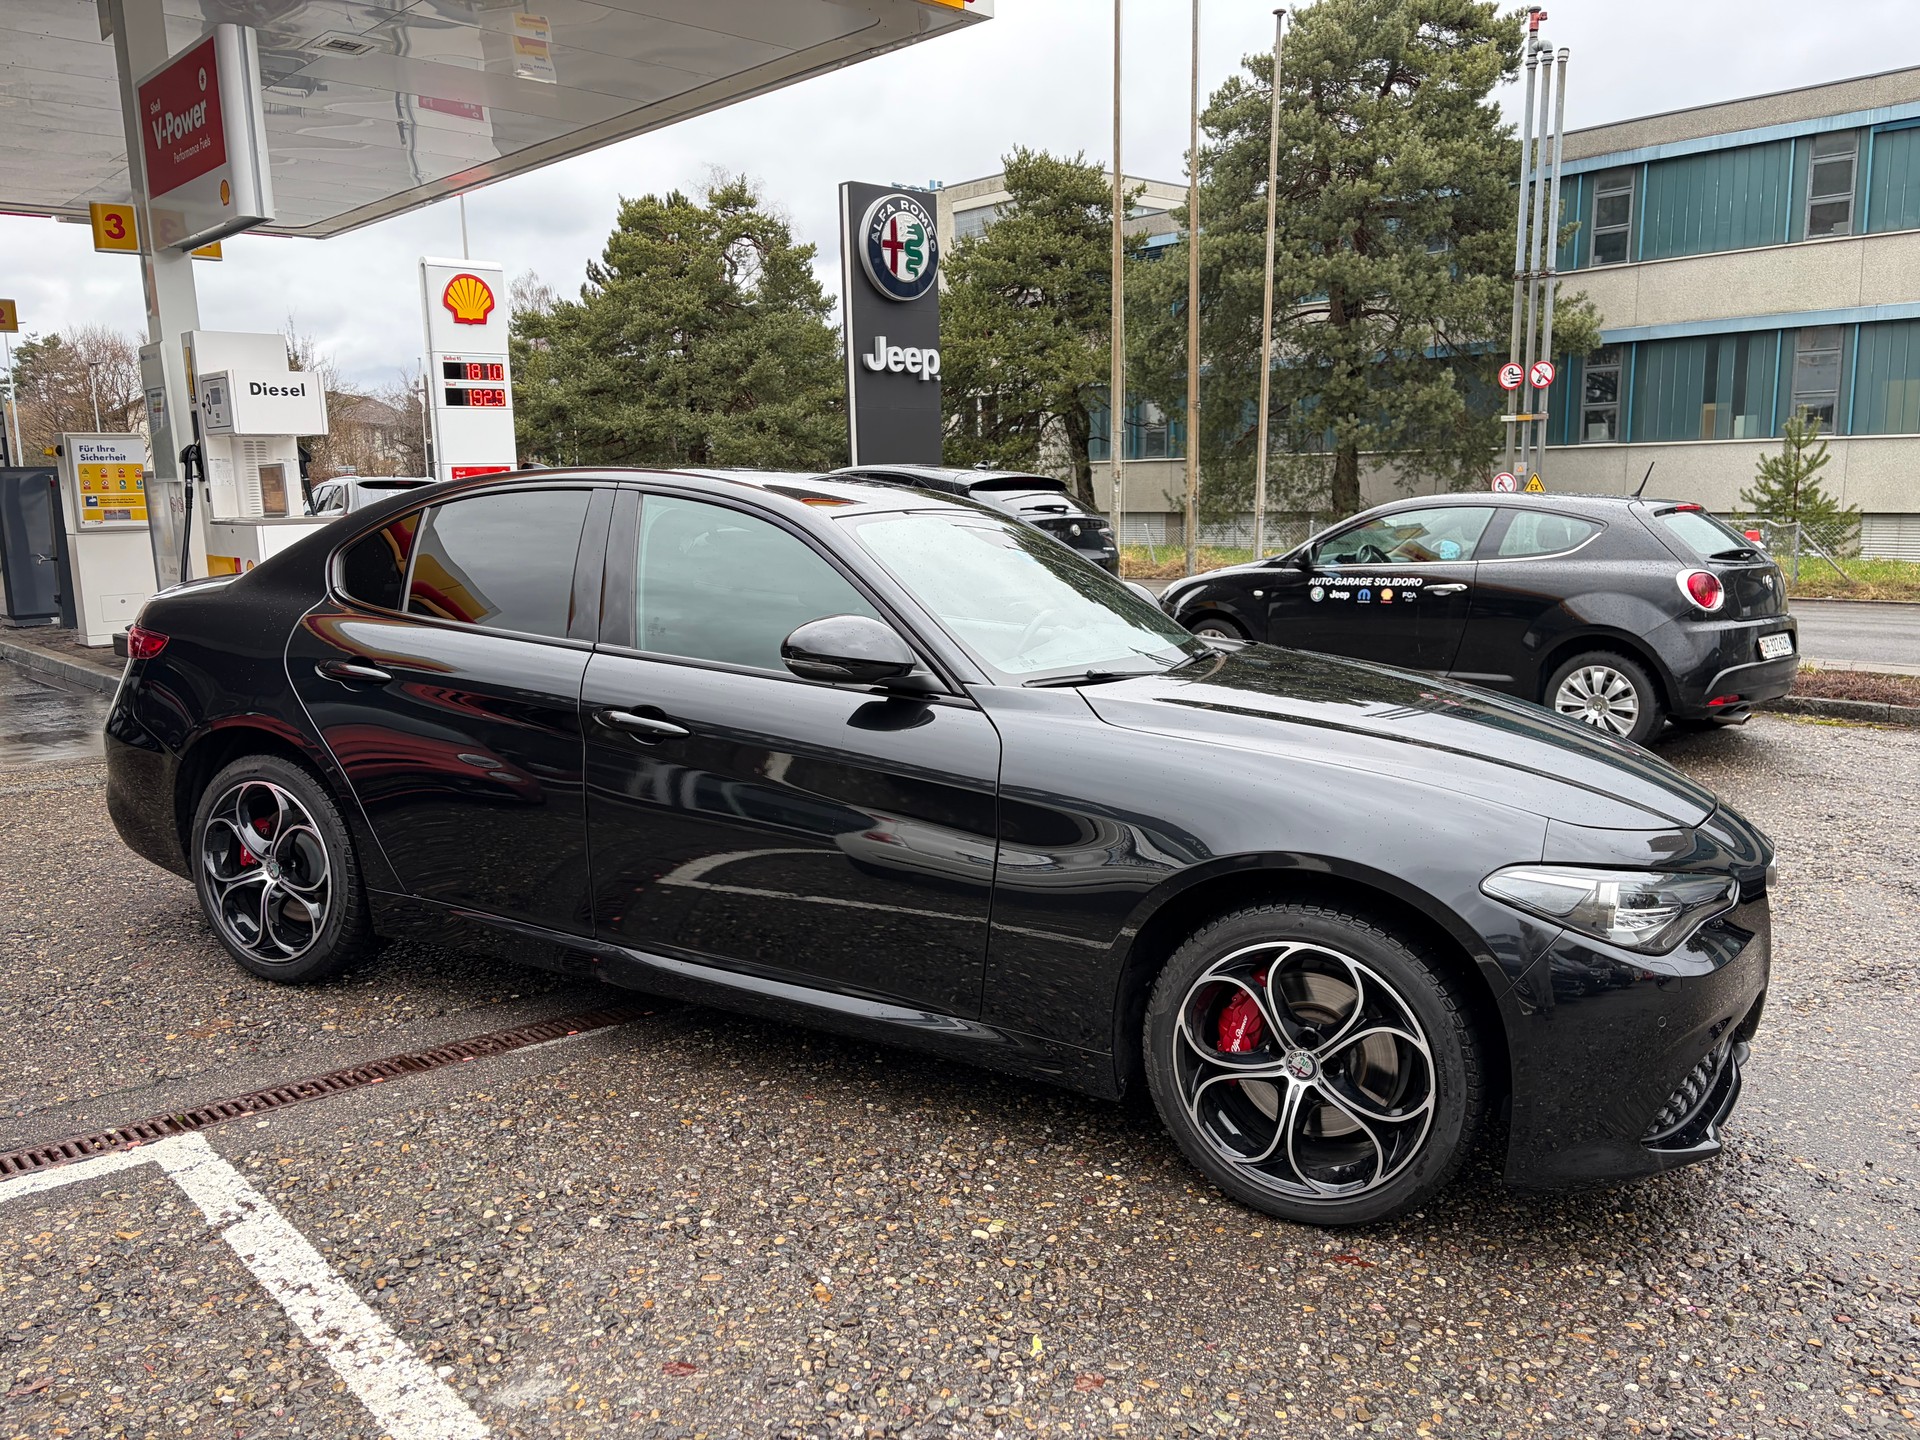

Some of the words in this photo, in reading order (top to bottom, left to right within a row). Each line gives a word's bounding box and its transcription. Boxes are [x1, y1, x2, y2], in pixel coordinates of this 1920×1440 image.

[150, 98, 161, 114] Shell
[152, 99, 207, 150] V-Power
[173, 146, 200, 164] Performance
[199, 132, 211, 153] Fuels
[104, 213, 126, 239] 3
[872, 203, 896, 244] ALFA
[900, 200, 937, 252] ROMEO
[862, 336, 941, 381] Jeep
[249, 382, 306, 397] Diesel
[468, 389, 505, 406] 192.9
[205, 393, 212, 415] 3
[79, 444, 94, 453] Für
[97, 444, 115, 453] Ihre
[80, 453, 127, 461] Sicherheit
[1308, 577, 1373, 587] AUTO-GARAGE
[1373, 577, 1423, 587] SOLIDORO
[1329, 589, 1351, 600] Jeep
